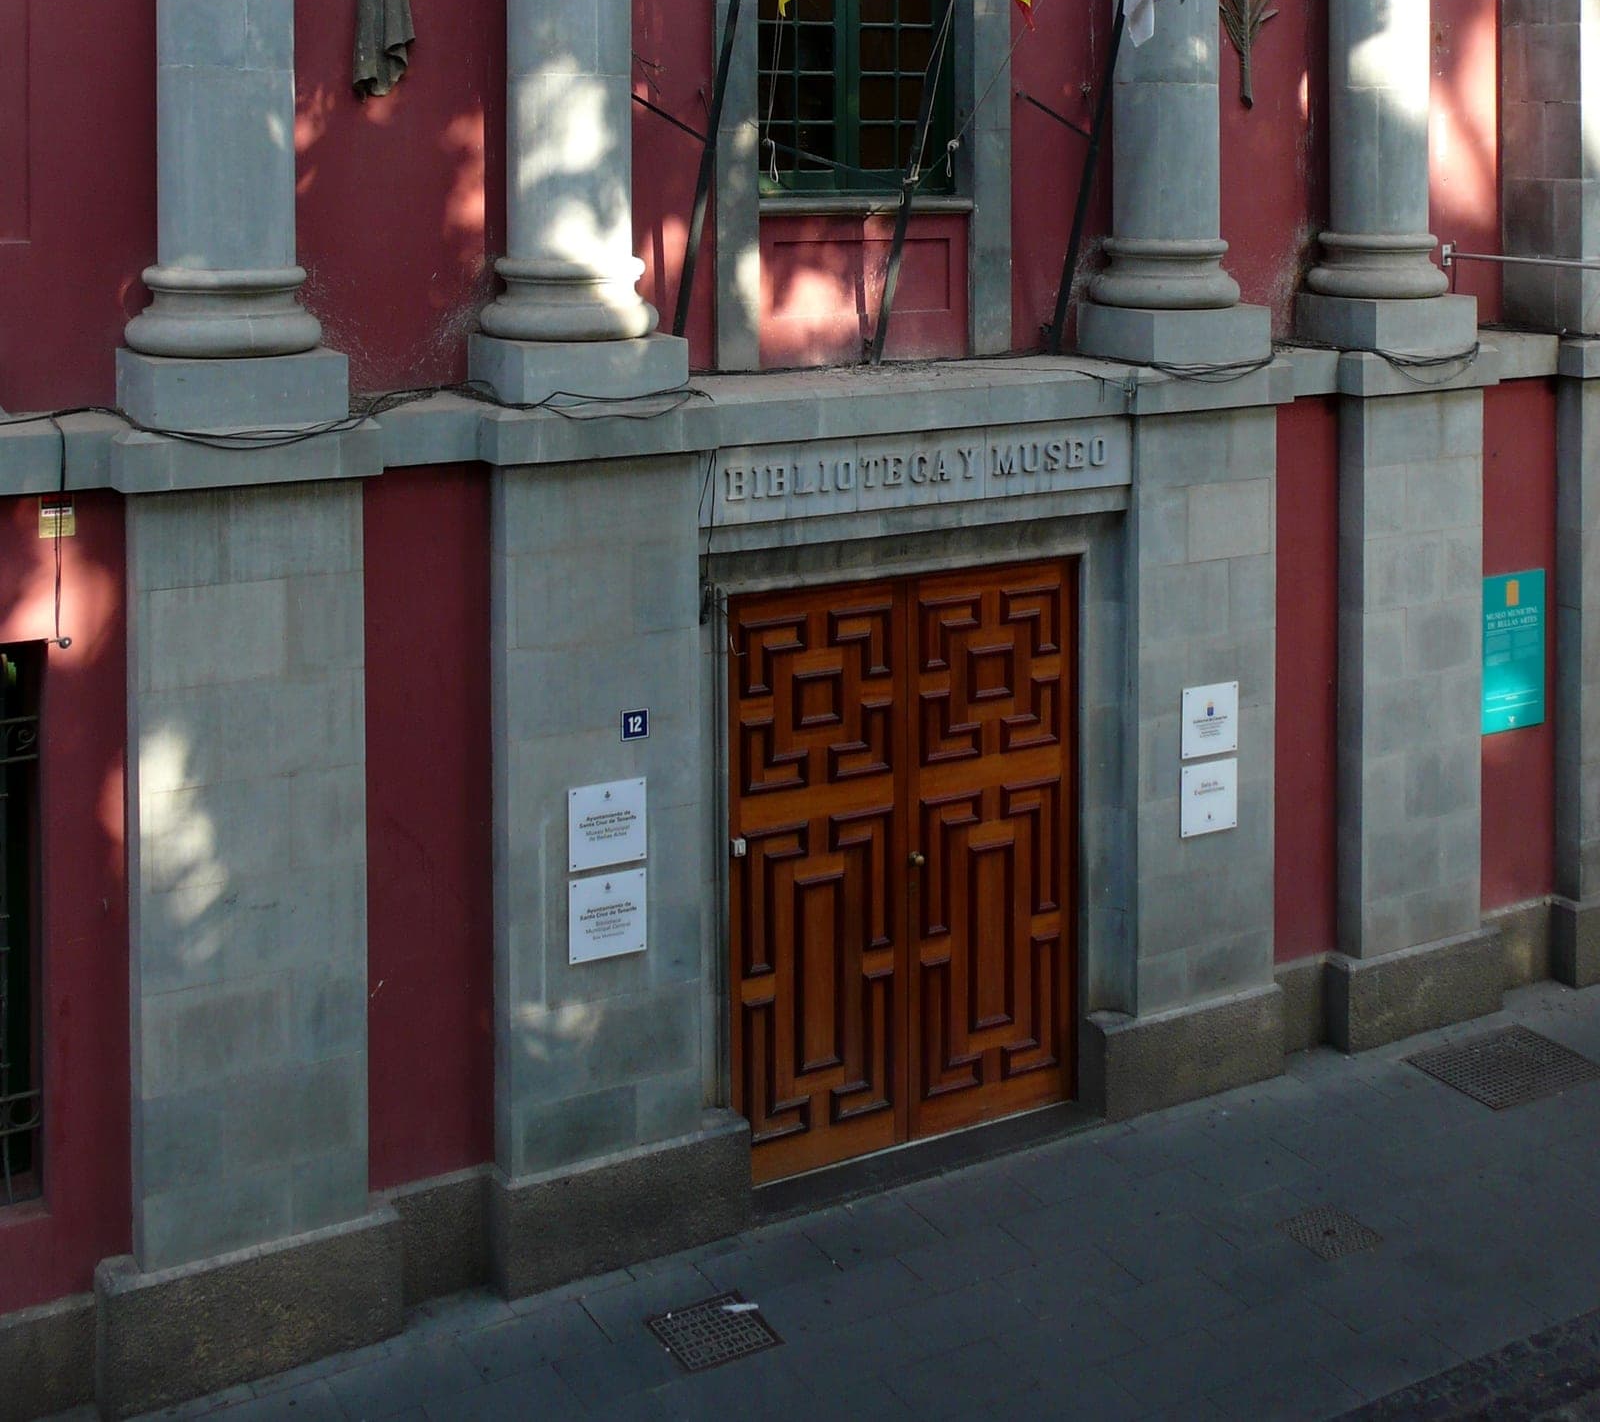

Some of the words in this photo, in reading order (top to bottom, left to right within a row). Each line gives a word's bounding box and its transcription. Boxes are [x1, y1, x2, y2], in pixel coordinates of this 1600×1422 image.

[725, 450, 950, 501] BIBLIOTECA
[958, 445, 982, 479] Y
[991, 435, 1109, 477] MUSEO
[628, 715, 642, 733] 12
[579, 821, 595, 829] Santa
[616, 814, 637, 822] Tenerife
[586, 811, 623, 822] Ayuntamiento
[587, 903, 624, 914] Ayuntamiento
[617, 906, 637, 914] Tenerife
